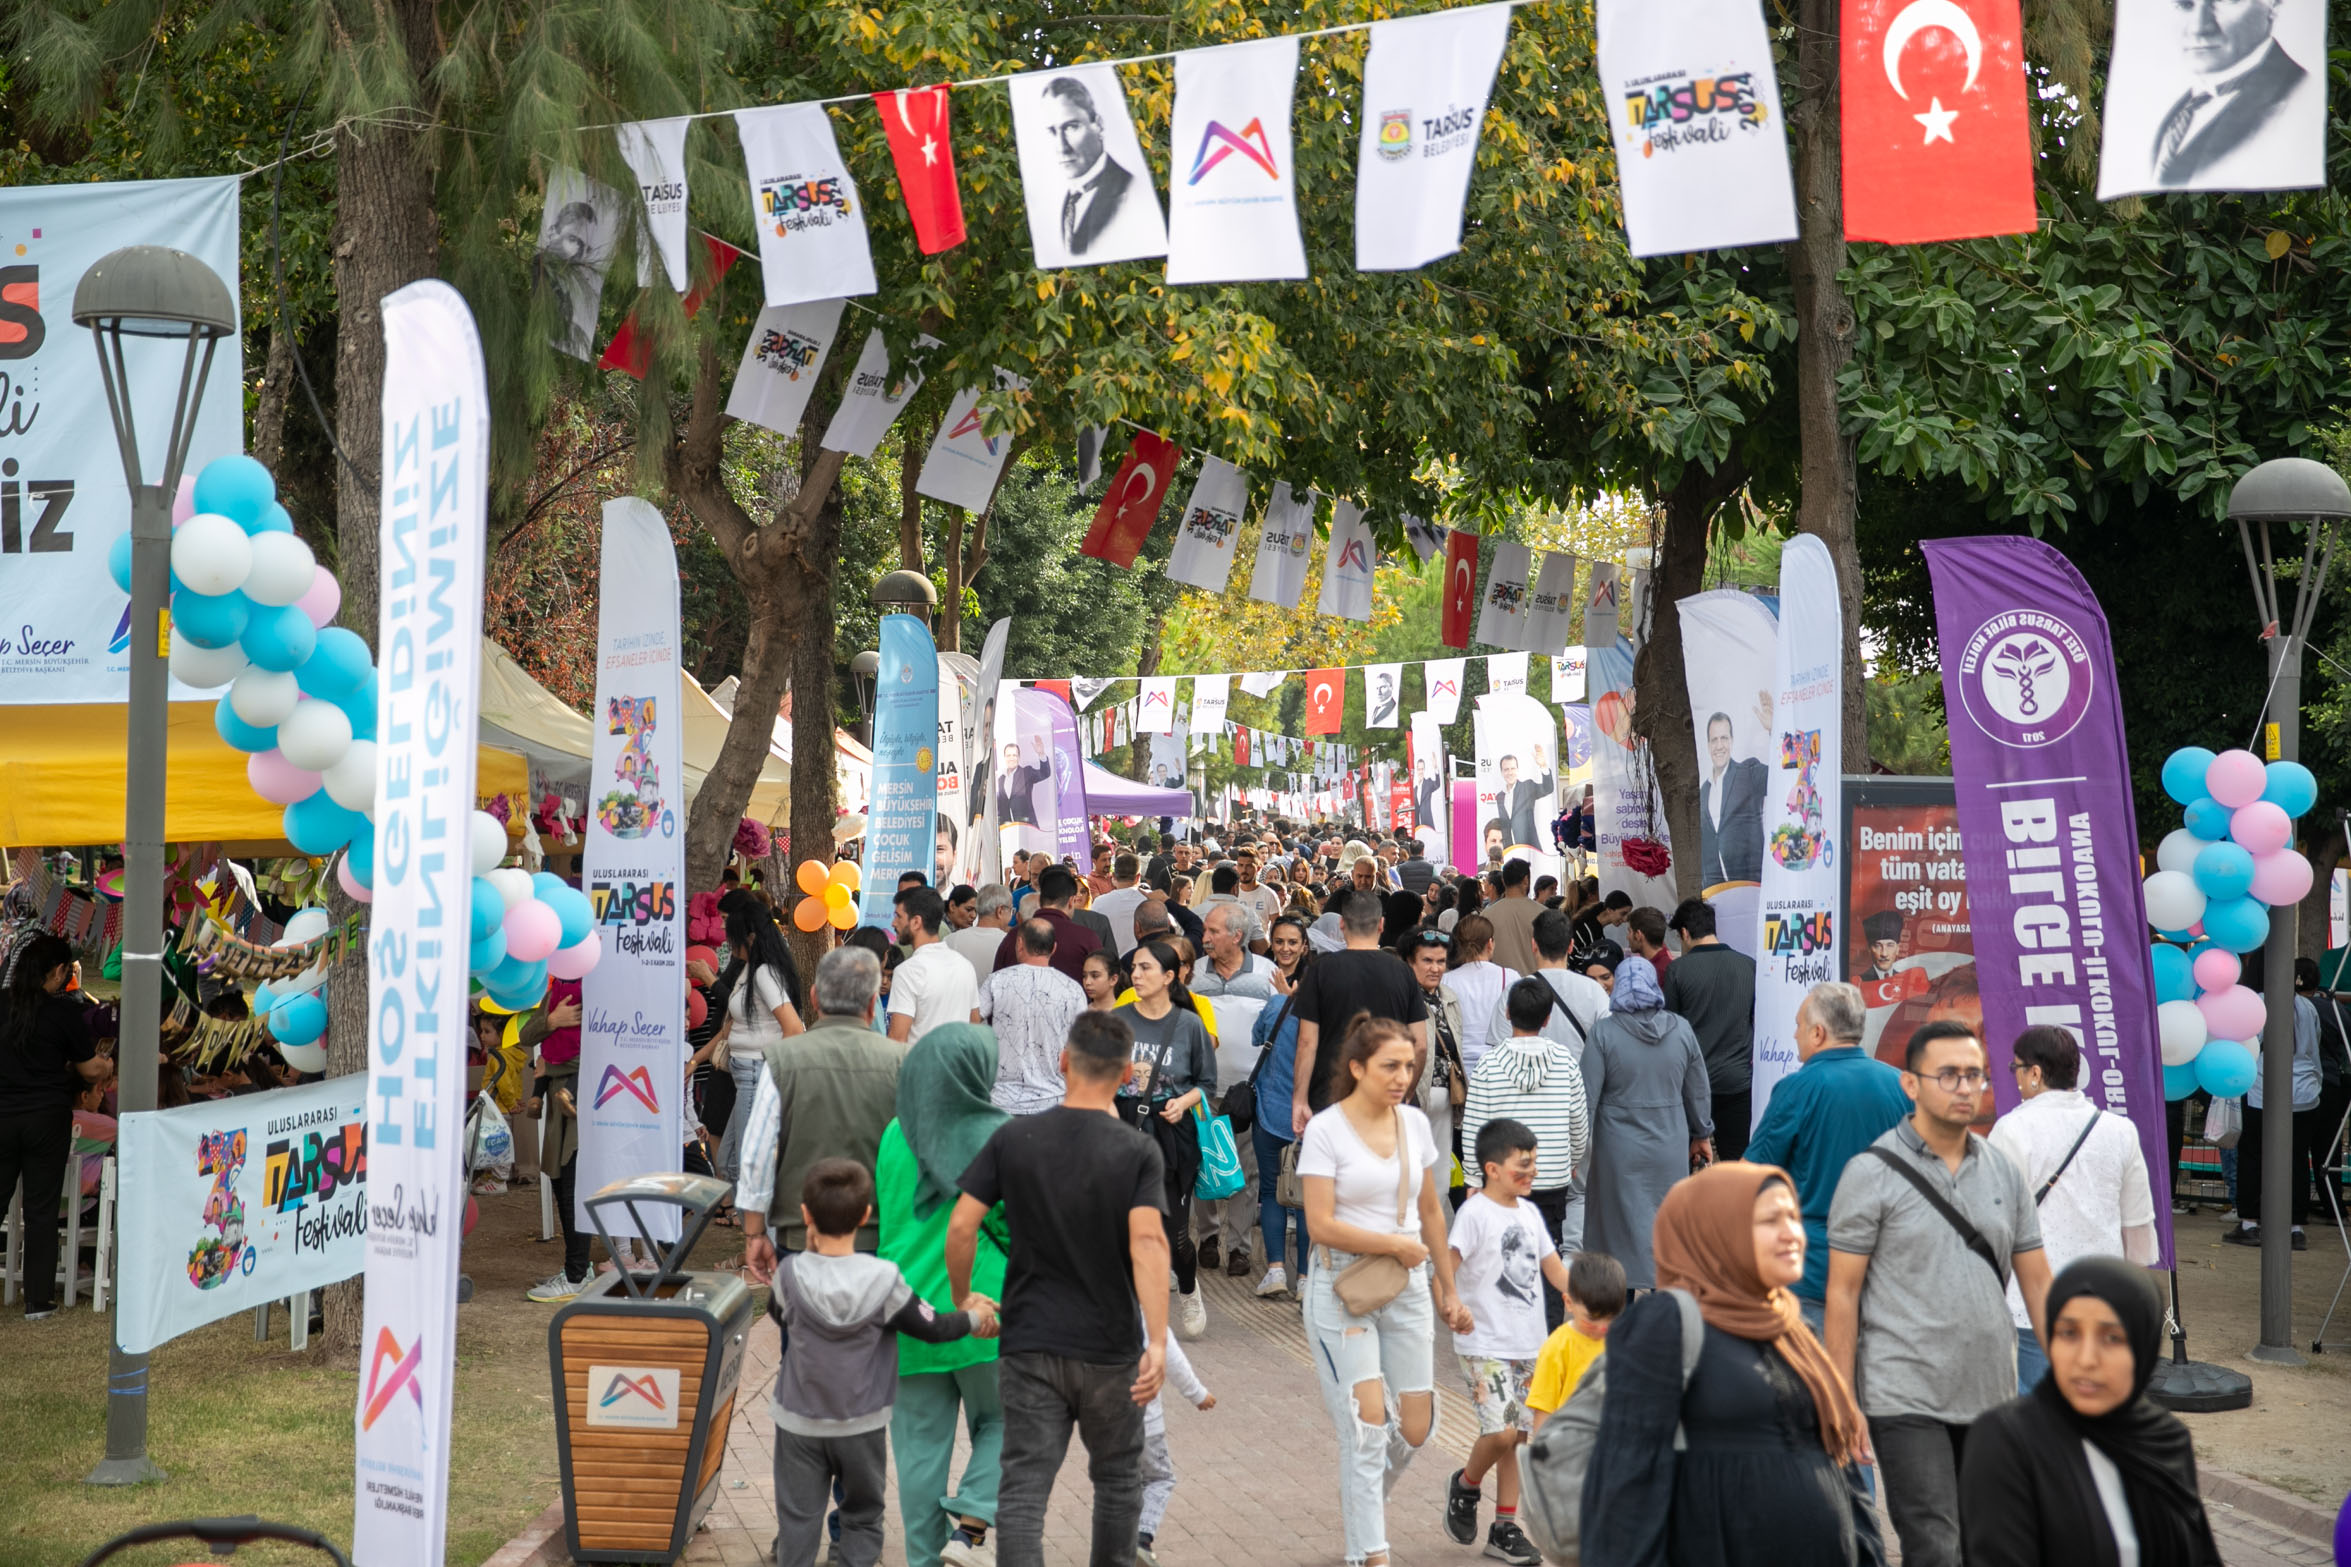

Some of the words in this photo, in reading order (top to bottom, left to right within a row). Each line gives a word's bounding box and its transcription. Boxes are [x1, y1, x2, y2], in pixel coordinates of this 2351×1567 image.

[1625, 77, 1739, 130] TARSUS
[1647, 117, 1730, 152] Festivali
[761, 180, 833, 216] TARSUS
[779, 209, 832, 232] Festivali
[17, 625, 75, 657] Seçer
[34, 666, 66, 675] BAŞKANI
[44, 657, 90, 666] BÜYÜKŞEHİR
[877, 779, 914, 794] MERSİN
[876, 794, 934, 814] BÜYÜKŞEHİR
[874, 812, 926, 829] BELEDİYESİ
[873, 833, 910, 849] ÇOCUK
[1860, 826, 1924, 851] Benim
[871, 847, 913, 865] GELİŞİM
[1880, 856, 1920, 880] tüm
[593, 868, 649, 878] ULUSLARARASI
[591, 882, 675, 926] TARSUS
[1766, 899, 1814, 910] ULUSLARARASI
[1895, 885, 1933, 915] eşit
[1937, 891, 1962, 916] oy
[615, 921, 675, 959] Festivali
[1764, 911, 1833, 957] TARSUS
[1932, 923, 1971, 934] (ANAYASA
[1785, 954, 1833, 987] Festivali
[588, 1008, 628, 1046] Vahap
[631, 1010, 666, 1037] Seçer
[1759, 1036, 1795, 1074] Vahap
[267, 1107, 338, 1136] ULUSLARARASI
